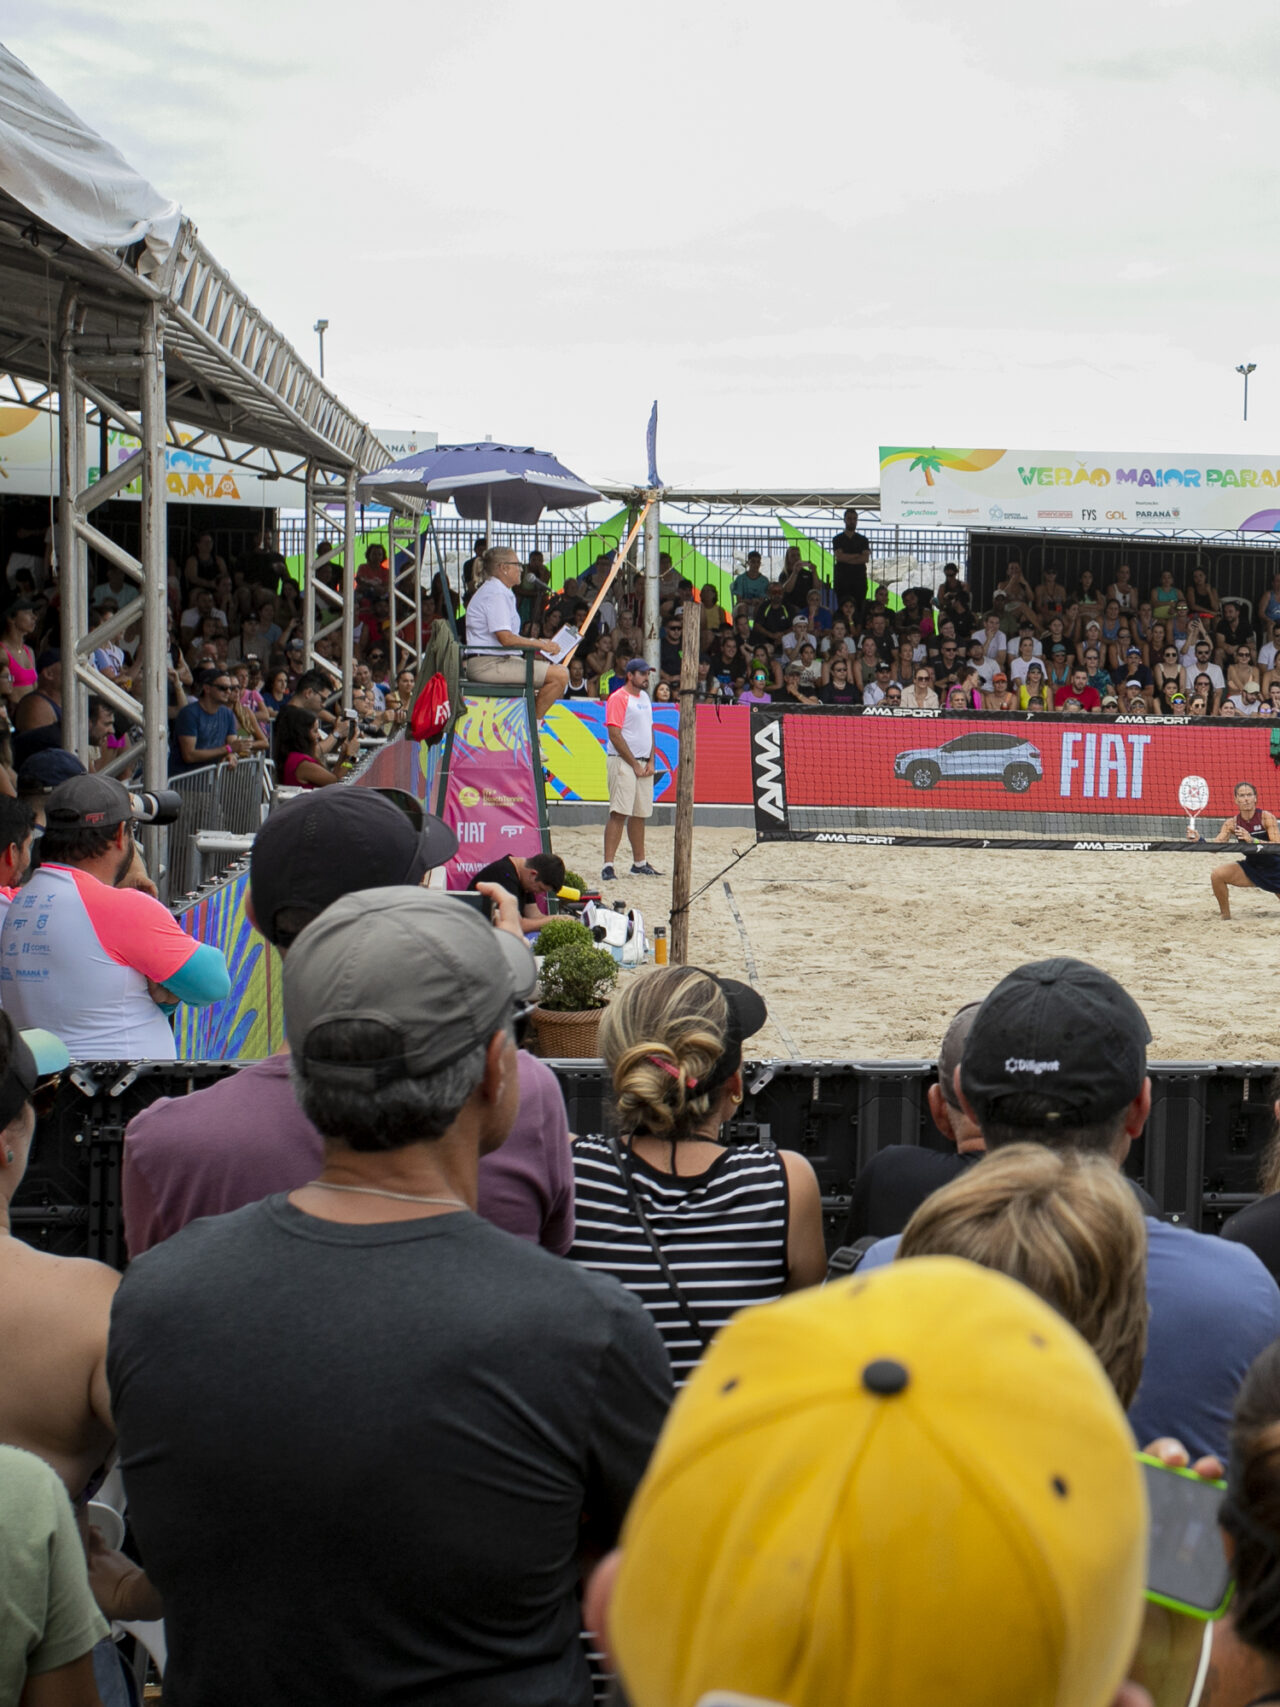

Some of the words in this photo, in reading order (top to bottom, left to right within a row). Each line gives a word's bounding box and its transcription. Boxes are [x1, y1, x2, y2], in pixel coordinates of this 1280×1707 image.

[1017, 461, 1111, 487] VERÃO
[1116, 468, 1200, 488] MAIOR
[1081, 509, 1097, 520] FYS
[1105, 511, 1128, 520] GOL
[1136, 510, 1171, 518] PARANÁ
[862, 707, 892, 716] AMA
[893, 709, 942, 718] SPORT
[1115, 715, 1145, 724] AMA
[1145, 716, 1192, 725] SPORT
[754, 720, 785, 821] AMA
[1060, 732, 1151, 798] FIAT
[457, 822, 487, 843] FIAT
[815, 833, 846, 842] AMA
[846, 835, 895, 845] SPORT
[1073, 842, 1103, 850] AMA
[1103, 842, 1151, 851] SPORT
